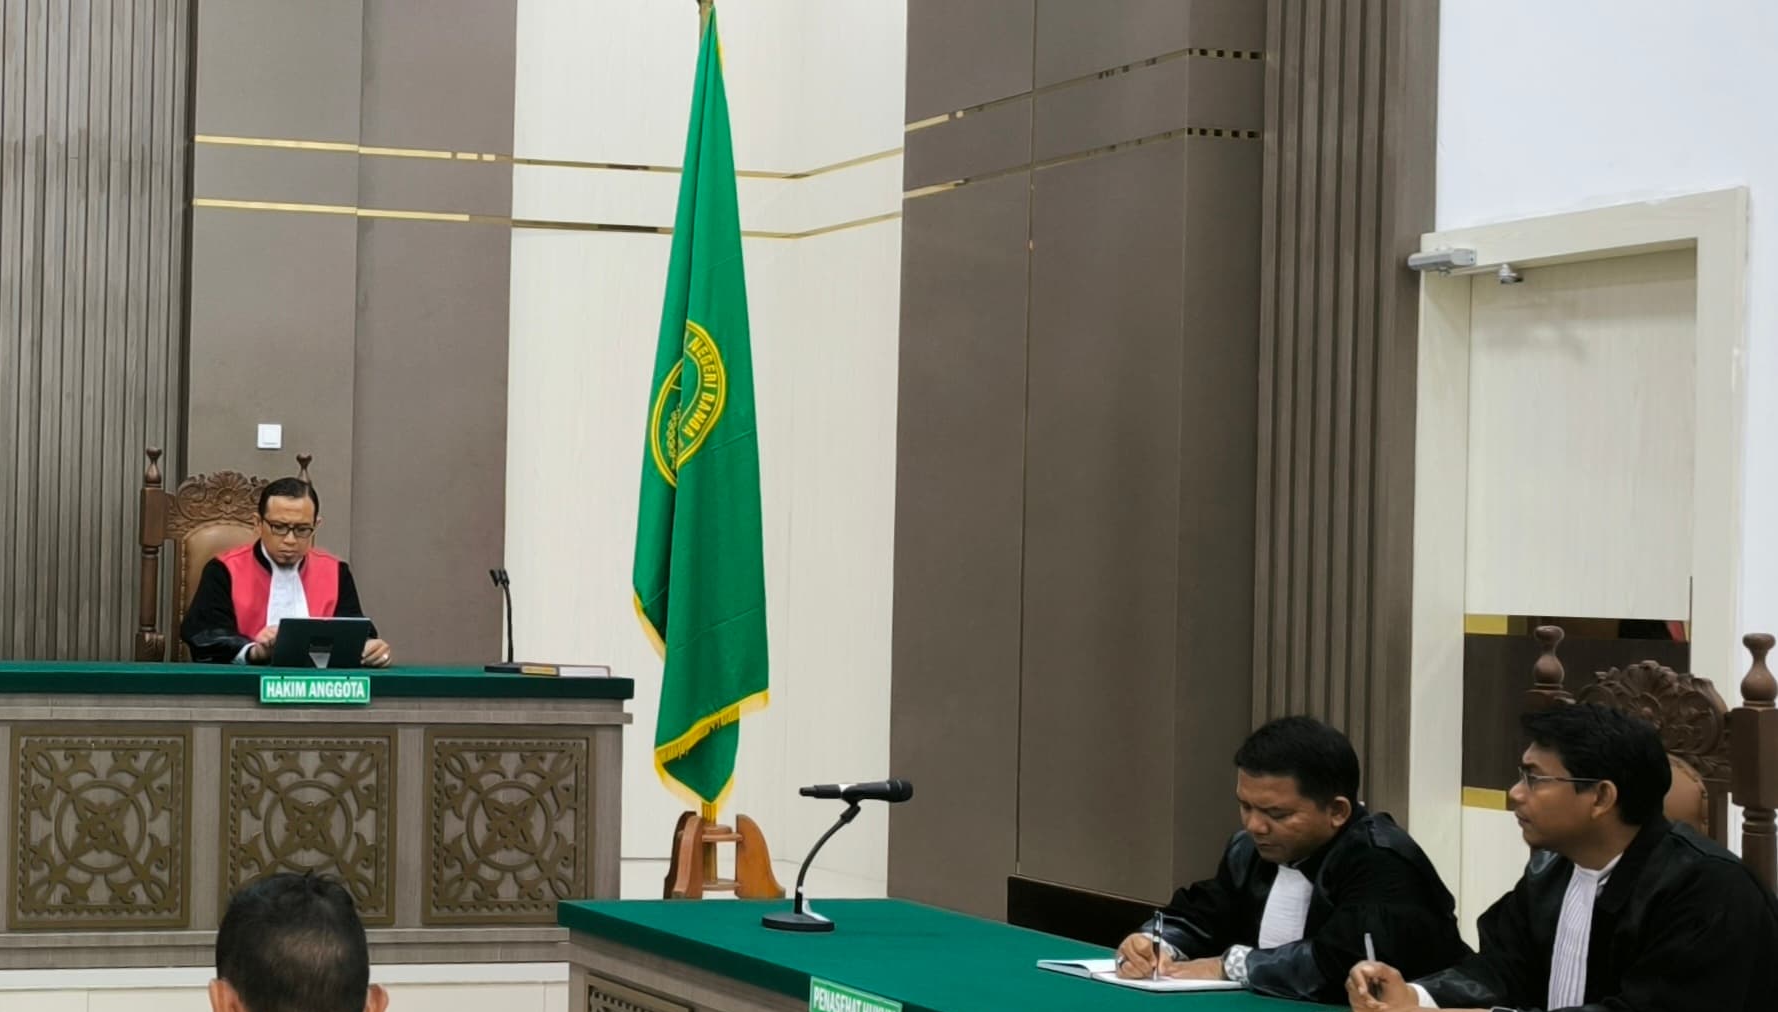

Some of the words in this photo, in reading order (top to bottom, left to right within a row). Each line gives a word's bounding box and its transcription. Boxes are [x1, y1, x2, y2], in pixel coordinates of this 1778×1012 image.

[688, 337, 717, 387] NEGERI
[266, 681, 306, 698] HAKIM
[308, 681, 365, 698] ANGGOTA
